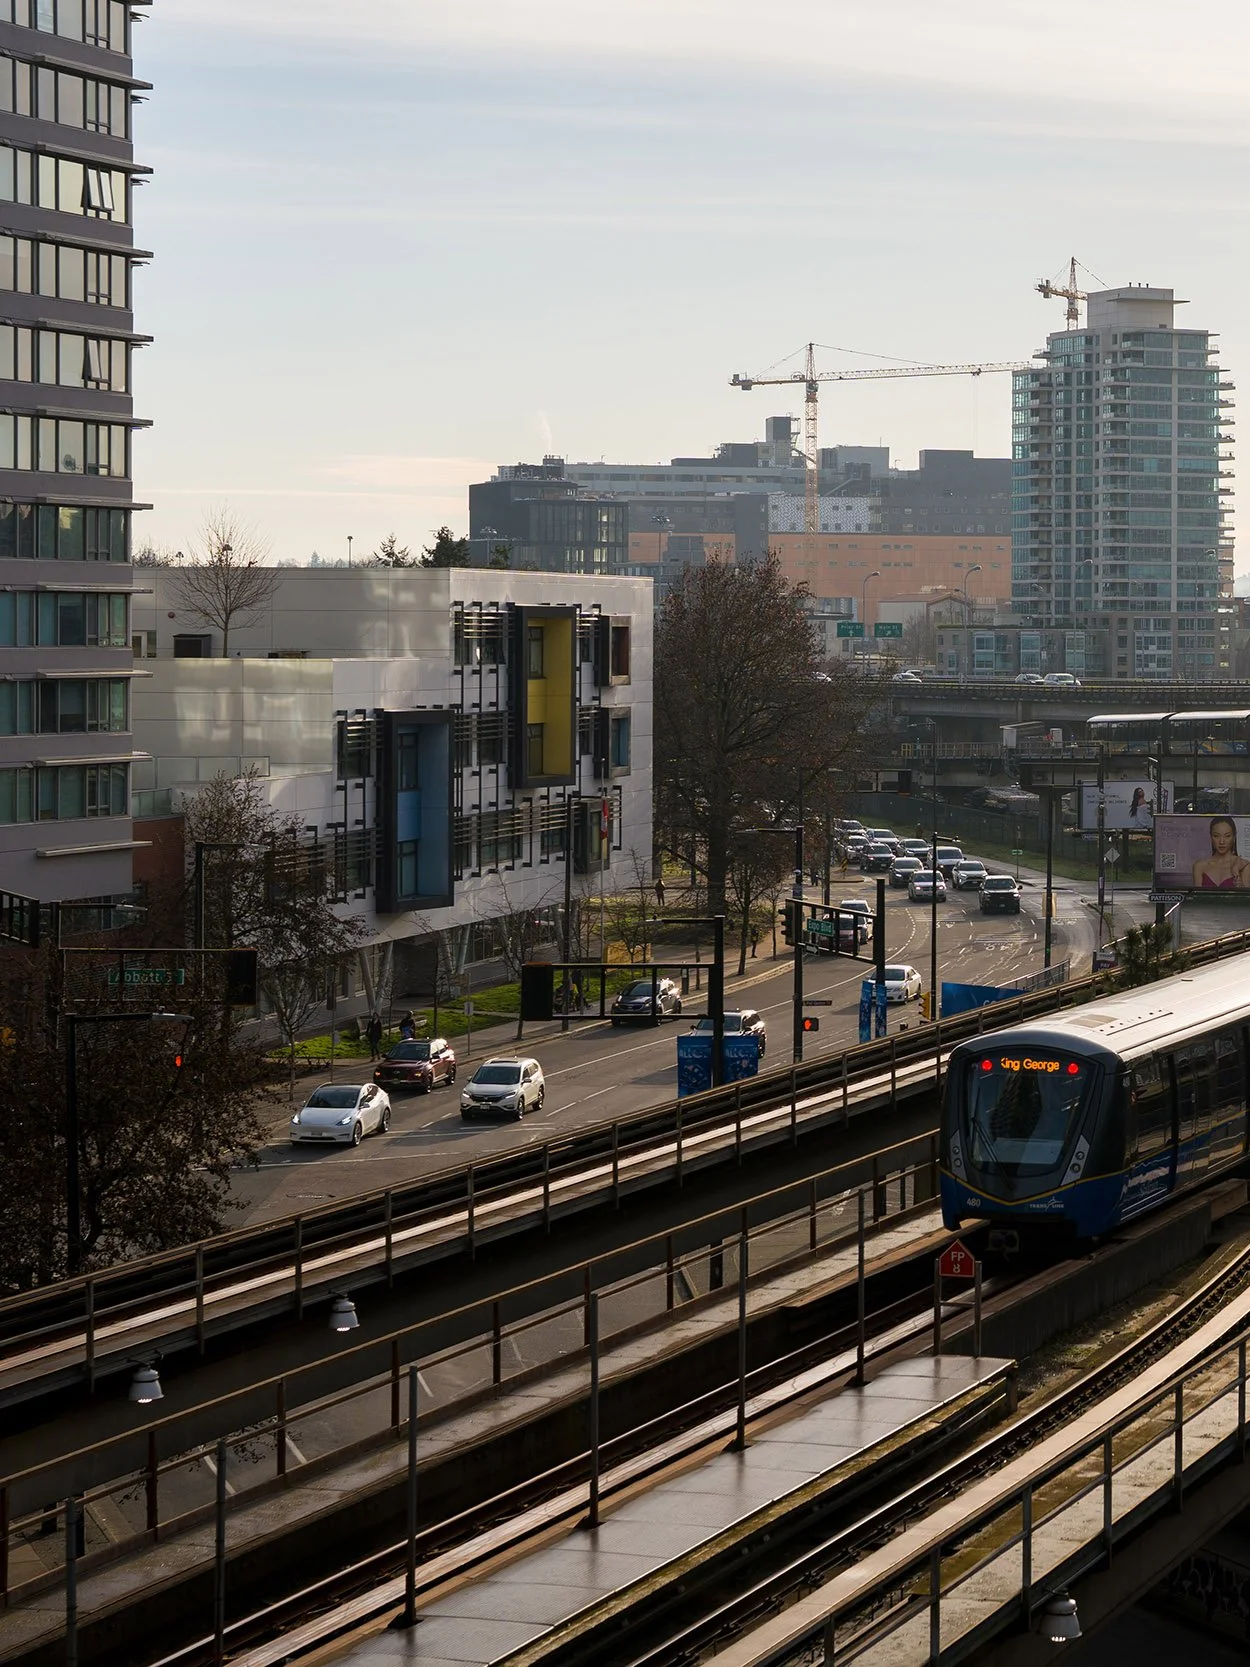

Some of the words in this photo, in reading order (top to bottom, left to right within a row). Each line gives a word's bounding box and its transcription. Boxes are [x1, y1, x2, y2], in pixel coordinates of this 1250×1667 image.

[808, 920, 820, 931] Expo
[820, 921, 832, 933] Blvd
[1000, 1057, 1020, 1071] King
[1023, 1058, 1060, 1072] George
[966, 1197, 981, 1208] 480
[951, 1251, 965, 1262] FP
